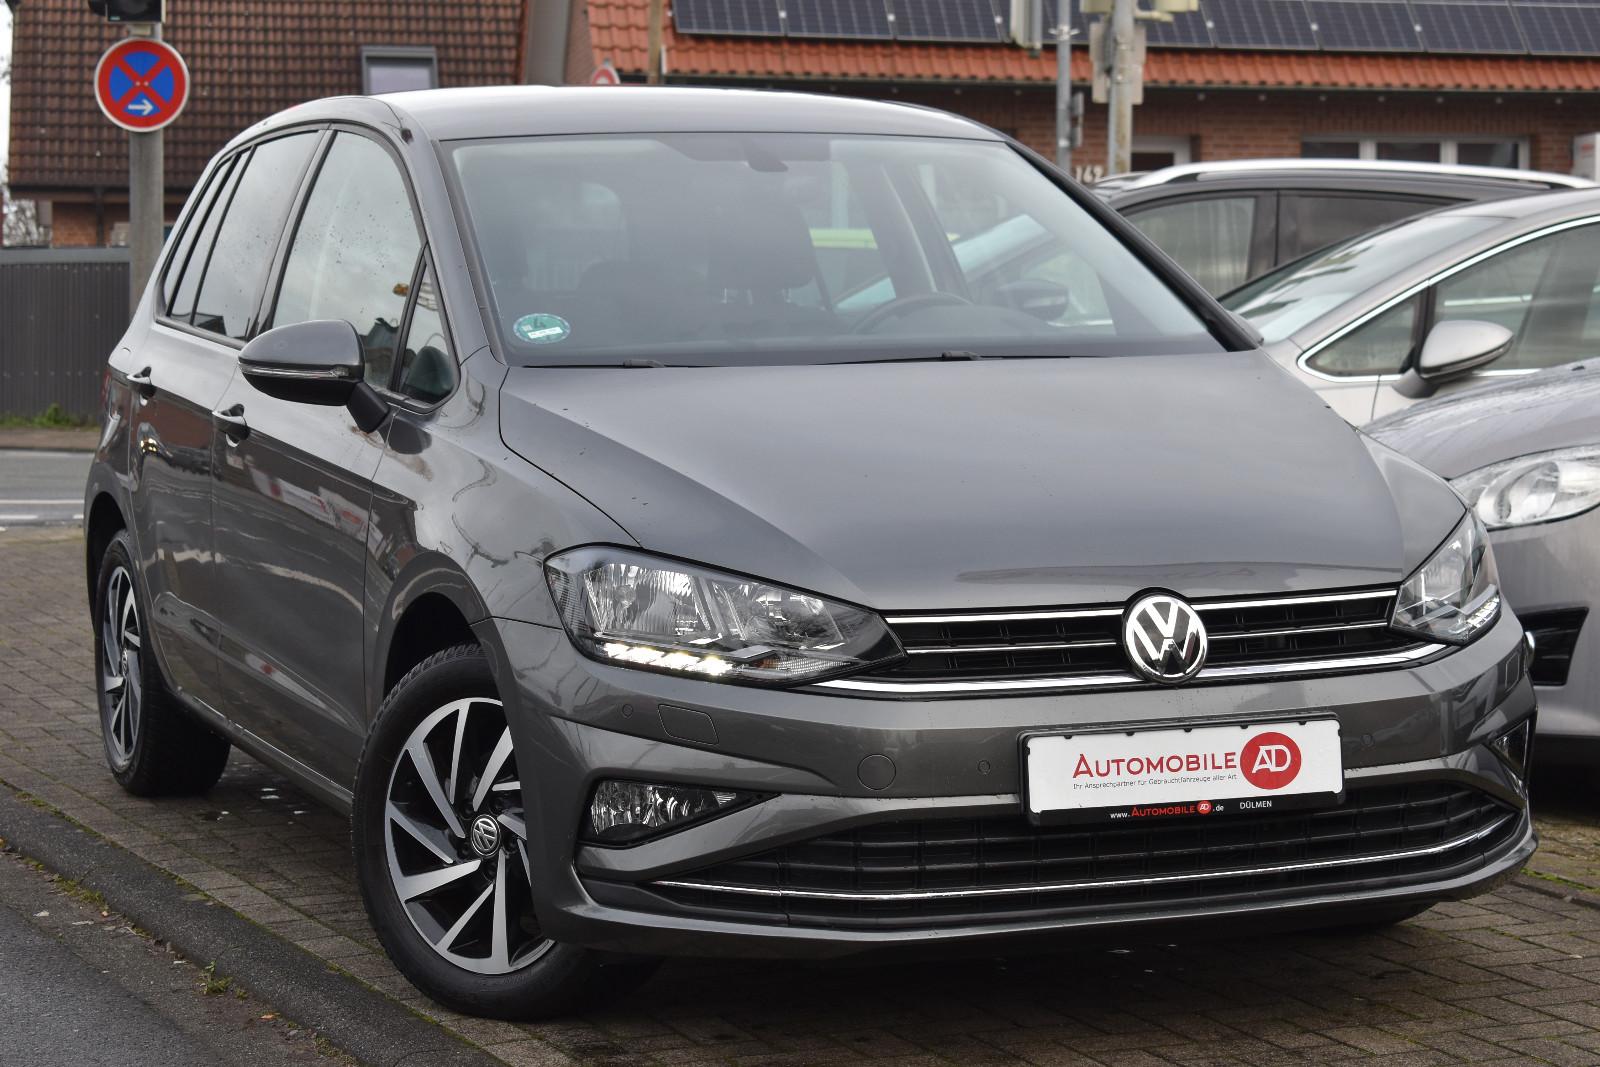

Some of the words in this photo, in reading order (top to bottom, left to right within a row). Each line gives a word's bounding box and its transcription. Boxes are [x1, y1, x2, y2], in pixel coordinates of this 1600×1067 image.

[1072, 752, 1237, 778] AUTOMOBILE
[1252, 744, 1291, 775] AD
[1240, 800, 1272, 810] DÜLMEN
